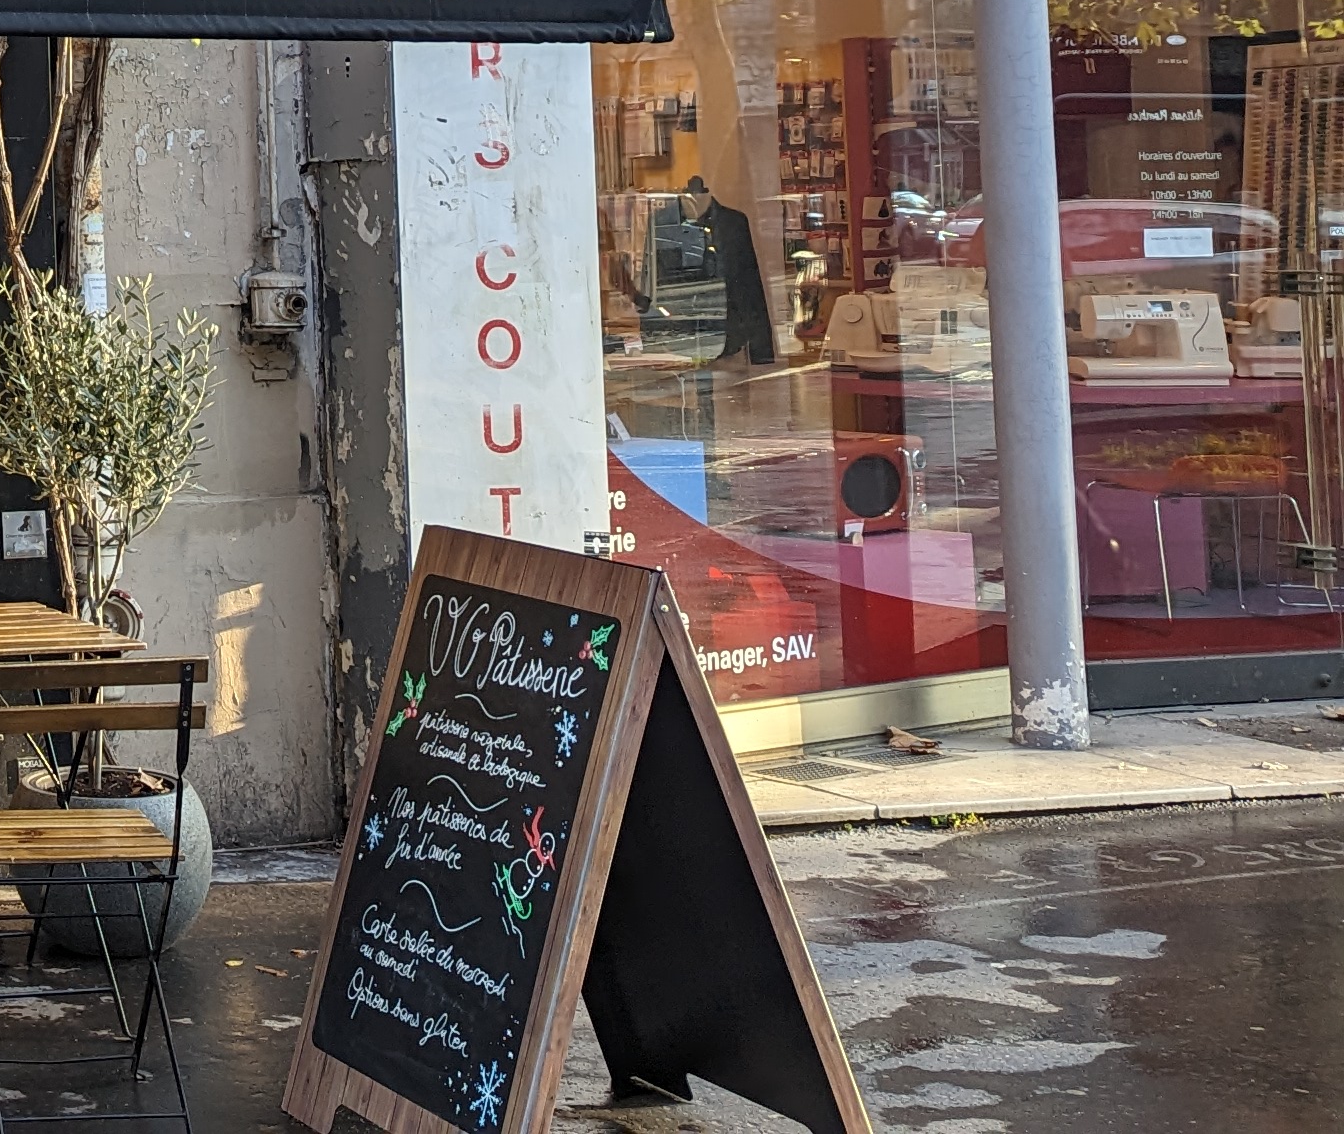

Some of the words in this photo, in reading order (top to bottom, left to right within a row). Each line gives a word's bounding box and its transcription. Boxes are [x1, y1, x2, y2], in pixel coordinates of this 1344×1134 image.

[1138, 151, 1174, 160] Horaires
[1140, 171, 1153, 180] Du
[1155, 171, 1175, 180] lundi
[1178, 172, 1189, 180] au
[1190, 170, 1220, 180] samedi
[771, 633, 817, 663] SAV.
[388, 786, 416, 820] Nos
[489, 820, 515, 849] de
[361, 904, 398, 945] Carte
[435, 946, 453, 973] du
[359, 943, 373, 960] au
[374, 951, 419, 982] samedi
[347, 967, 390, 1020] Options
